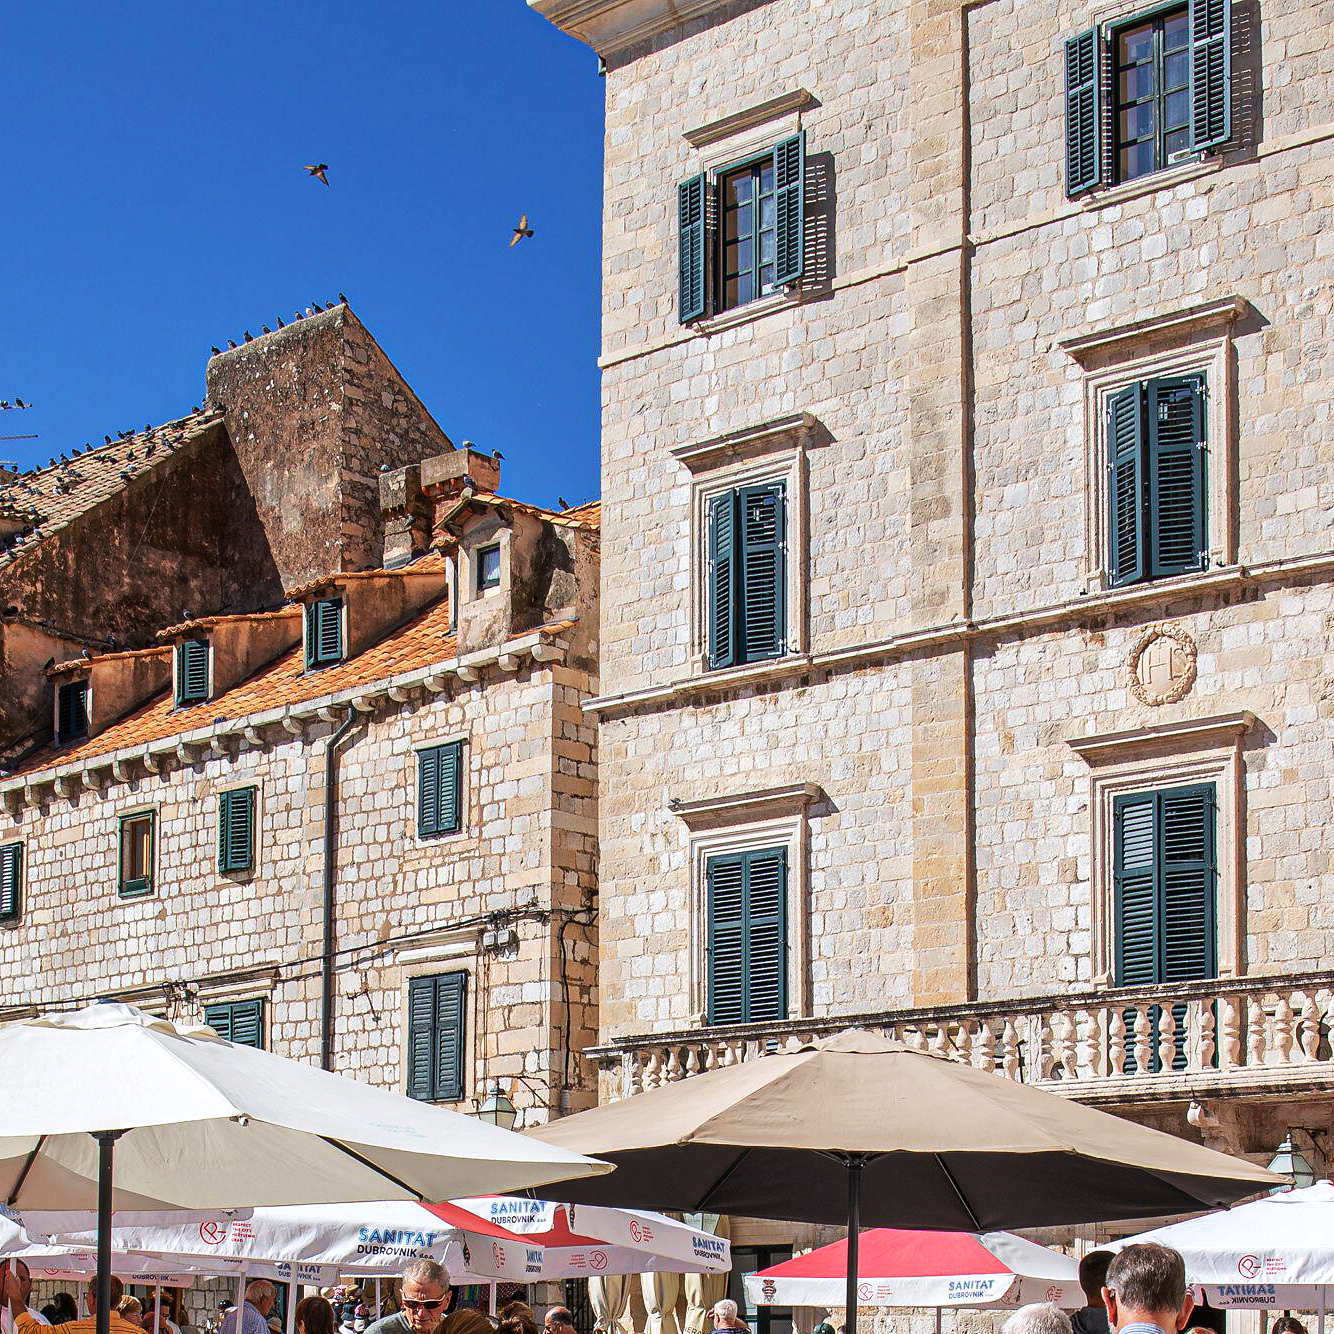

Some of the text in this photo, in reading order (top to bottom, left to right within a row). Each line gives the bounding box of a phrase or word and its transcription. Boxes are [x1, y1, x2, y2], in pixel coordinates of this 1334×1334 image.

[491, 1201, 547, 1214] SANITAT
[491, 1215, 535, 1225] DUBROVNIK
[358, 1228, 437, 1247] SANITAT
[357, 1244, 417, 1258] DUBROVNIK
[692, 1236, 725, 1253] SANITAT
[949, 1280, 995, 1291] SANITAT
[949, 1291, 984, 1299] DUBROVNIK
